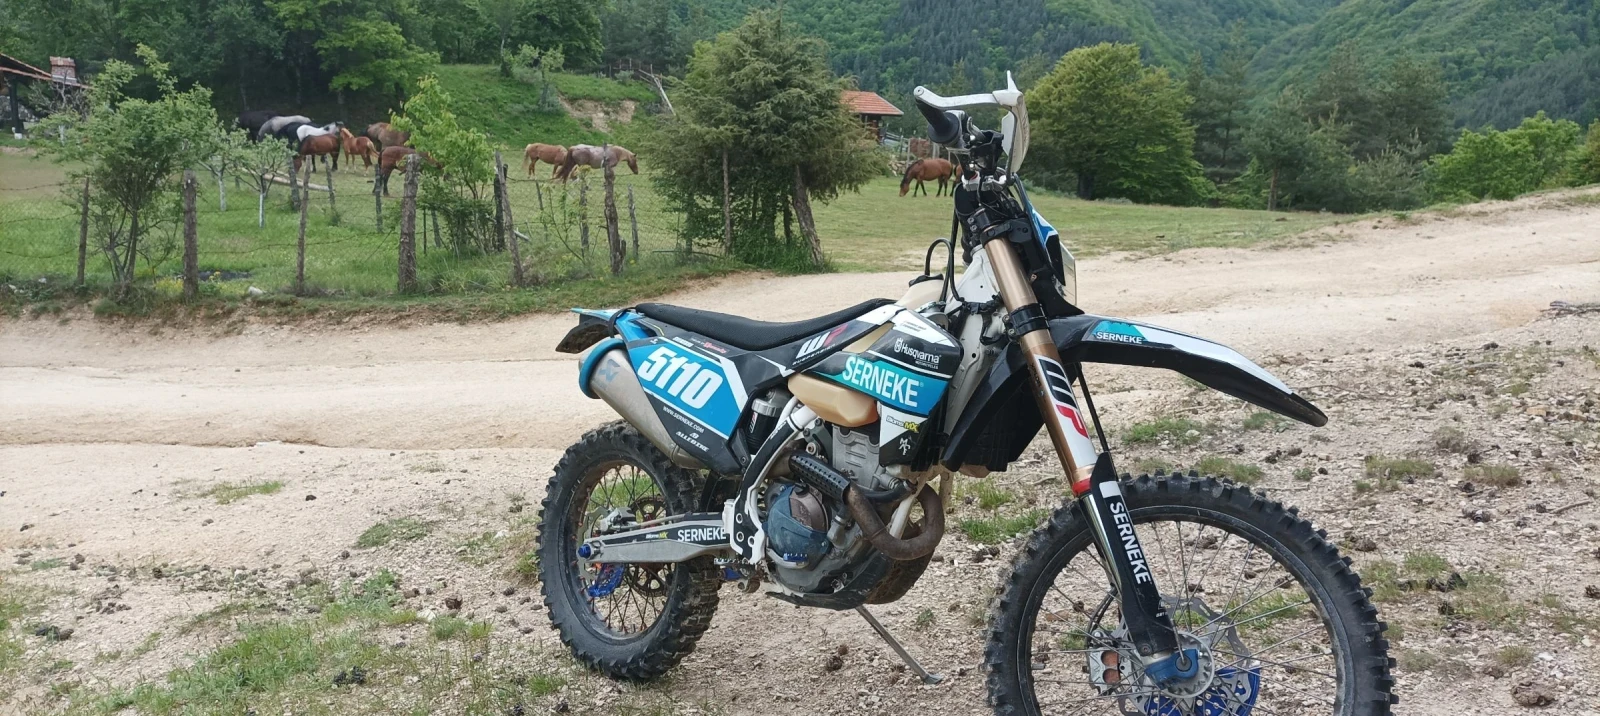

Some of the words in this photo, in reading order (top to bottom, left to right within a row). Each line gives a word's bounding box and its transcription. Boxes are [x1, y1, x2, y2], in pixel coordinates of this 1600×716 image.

[900, 343, 940, 364] Husqvarna
[1096, 331, 1143, 344] SERNEKE
[637, 346, 724, 410] 5110
[842, 356, 920, 408] SERNEKE
[677, 527, 727, 542] SERNEKE
[1109, 501, 1152, 585] SERNEKE
